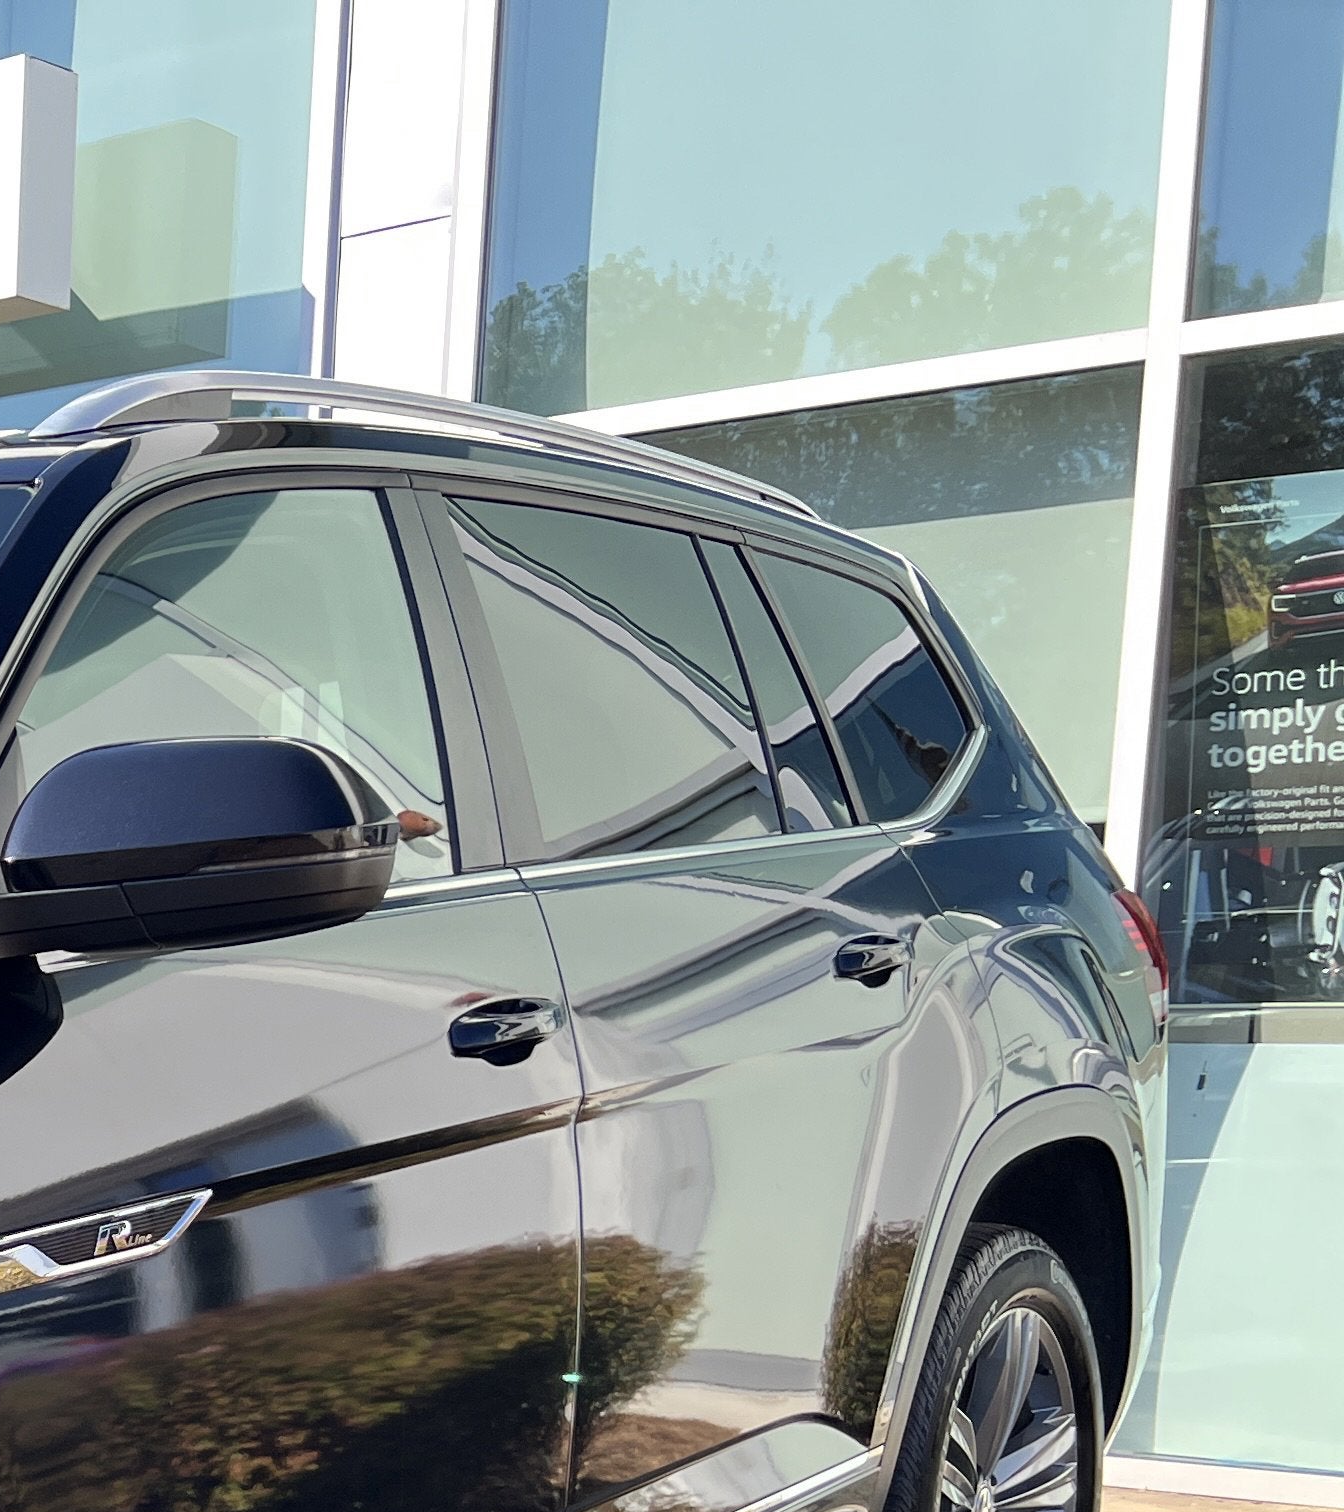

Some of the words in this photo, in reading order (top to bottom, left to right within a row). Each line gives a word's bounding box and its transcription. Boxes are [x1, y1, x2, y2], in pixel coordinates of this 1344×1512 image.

[1212, 667, 1306, 696] Some
[1209, 698, 1326, 736] simply
[1207, 735, 1344, 774] togethe
